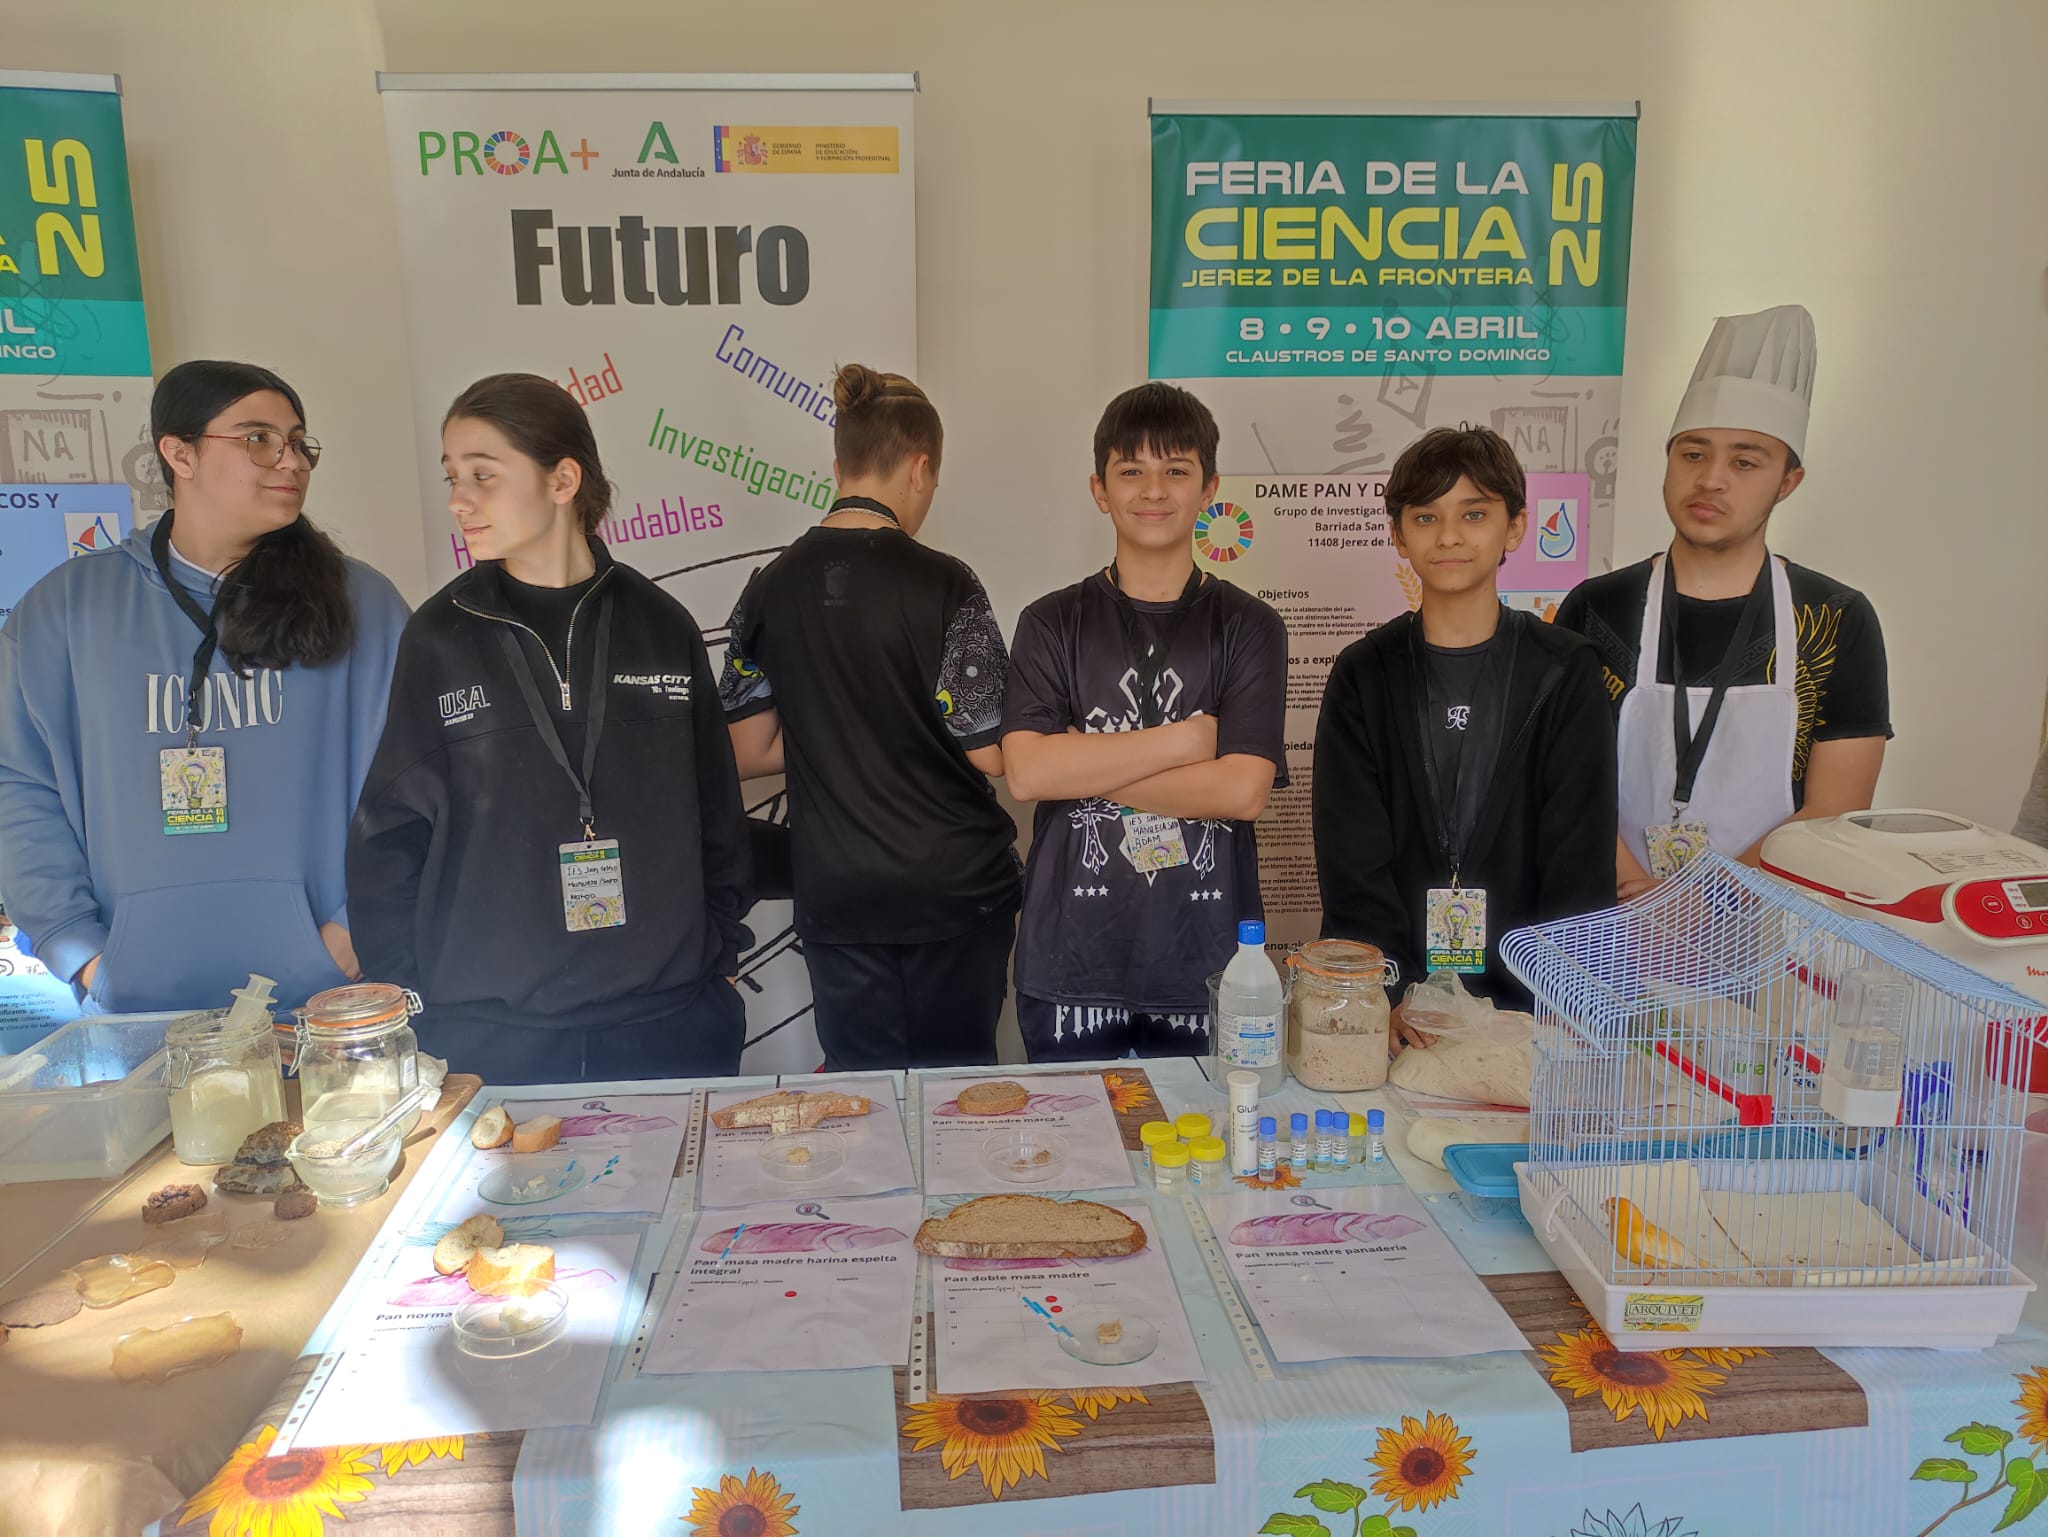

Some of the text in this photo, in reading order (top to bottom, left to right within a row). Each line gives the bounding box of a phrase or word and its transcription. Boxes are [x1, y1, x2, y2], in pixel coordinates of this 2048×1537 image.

[612, 166, 705, 179] Junta de Andalucía
[1187, 160, 1530, 195] FERIA DE LA
[24, 138, 104, 278] 25
[1548, 161, 1604, 288] 25
[1184, 205, 1528, 261] CIENCIA
[511, 209, 810, 306] Futuro
[1181, 267, 1534, 288] JEREZ DE LA FRONTERA
[1239, 316, 1539, 340] 8 9 10 ABRIL
[1225, 348, 1551, 363] CLAUSTROS DE SANTO DOMINGO
[1255, 483, 1308, 498] DAME
[1314, 483, 1351, 498] PAN
[1357, 483, 1368, 497] Y
[1273, 506, 1308, 518] Grupo
[1311, 506, 1324, 516] de
[1315, 522, 1385, 532] Barriada San
[1308, 538, 1339, 548] 11408
[1340, 537, 1368, 549] Jerez
[1371, 536, 1384, 547] de
[1257, 589, 1310, 601] Objetivos
[613, 674, 692, 686] KANSAS CITY
[167, 813, 214, 824] CIENCIA
[1024, 1116, 1057, 1124] marca
[1236, 1244, 1408, 1259] Pan masa madre panadería
[694, 1259, 718, 1267] Pan
[762, 1257, 803, 1265] madre
[807, 1255, 849, 1264] harina
[851, 1255, 898, 1264] espelta
[690, 1266, 742, 1277] integral
[944, 1275, 968, 1283] Pan
[971, 1273, 1007, 1282] doble
[1050, 1271, 1091, 1280] madre
[1631, 1304, 1697, 1315] ARQUIVET
[376, 1313, 402, 1321] Pan
